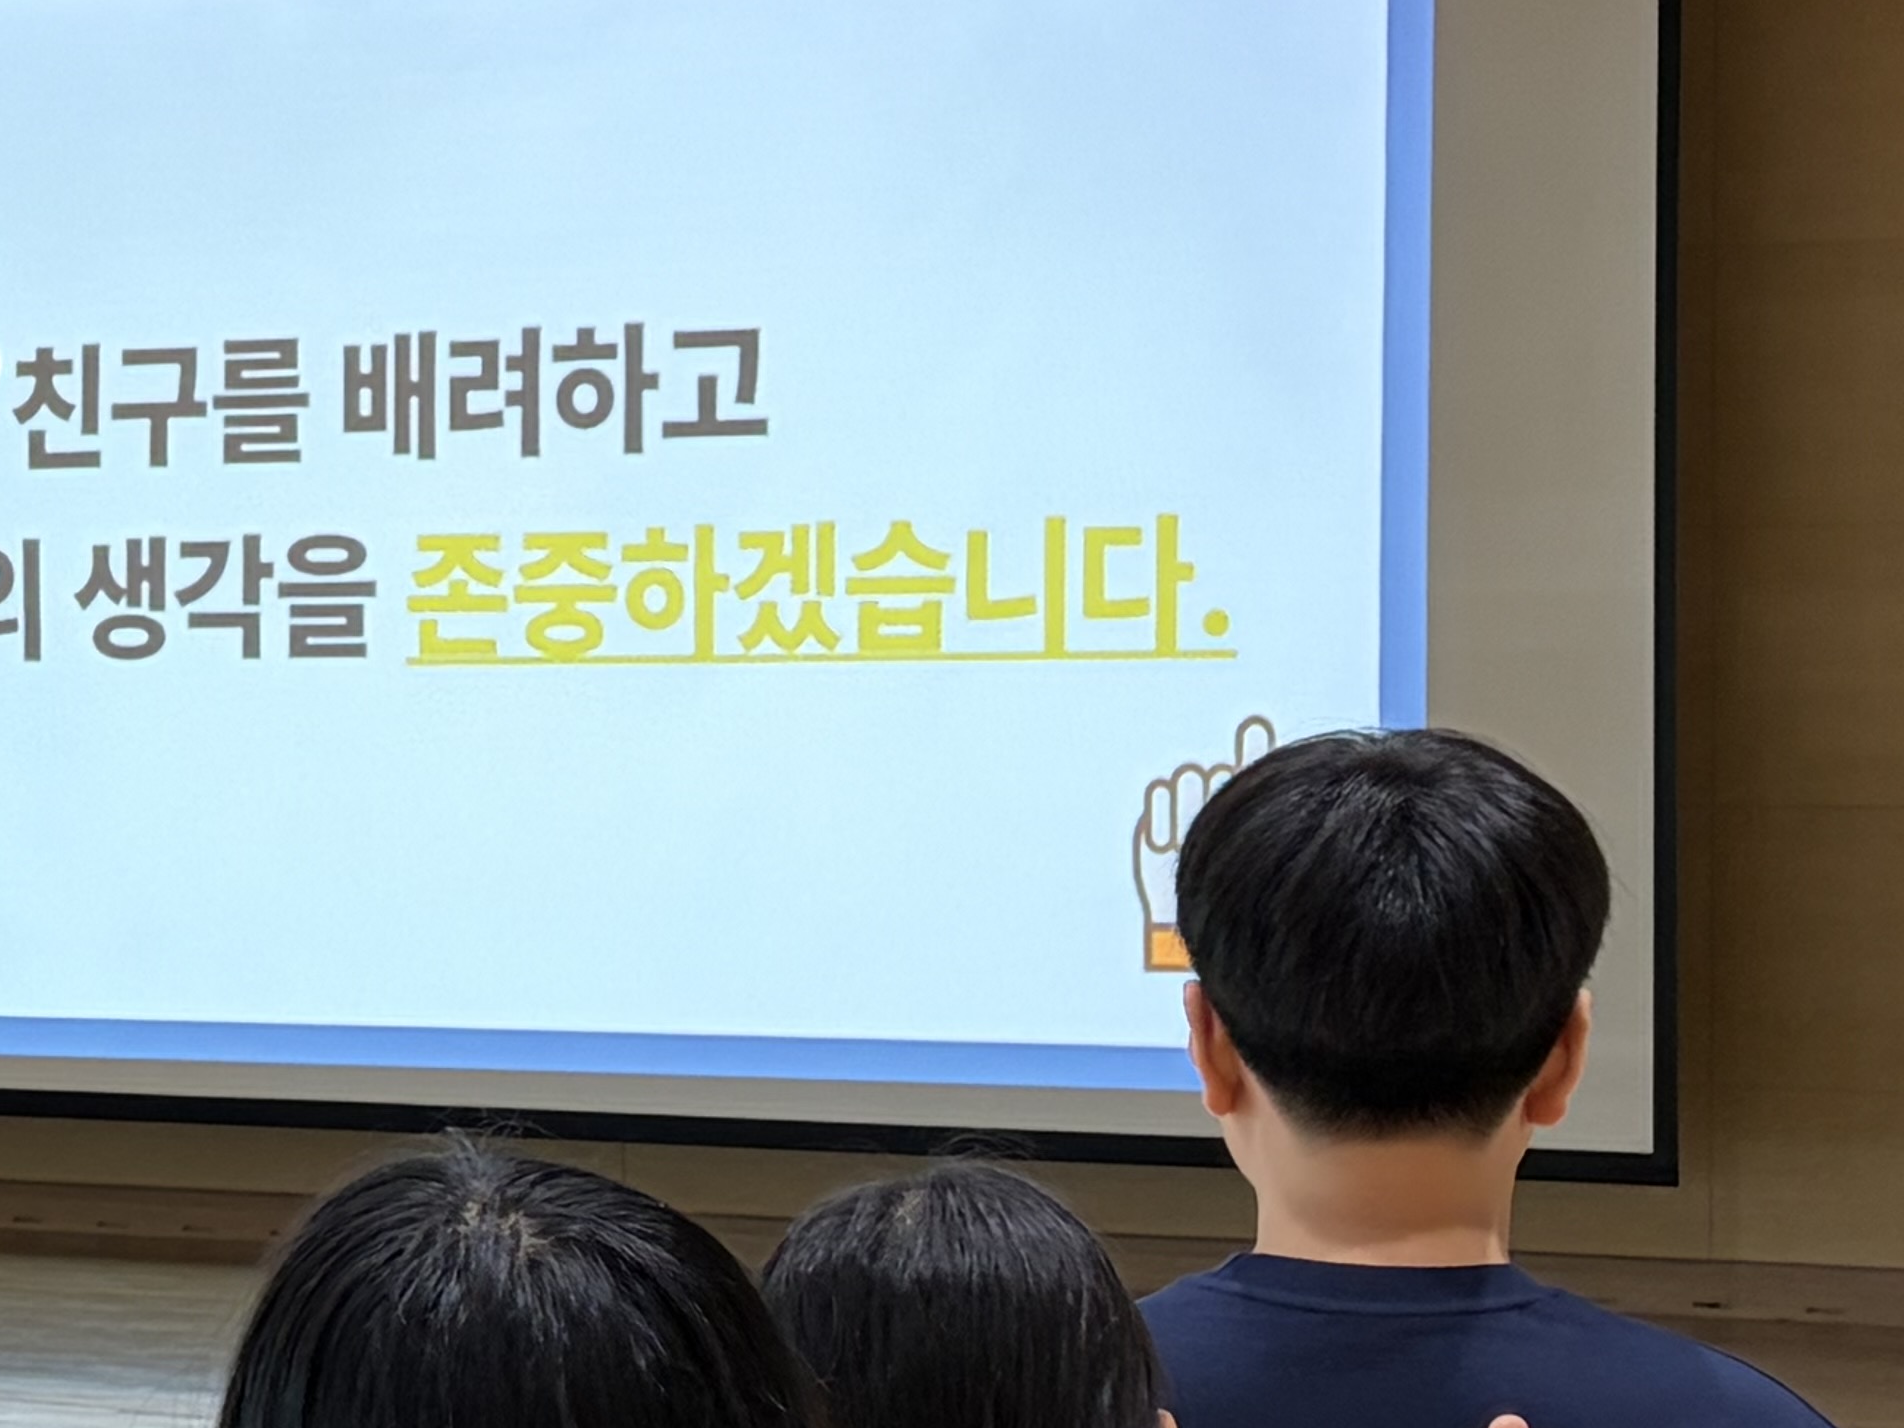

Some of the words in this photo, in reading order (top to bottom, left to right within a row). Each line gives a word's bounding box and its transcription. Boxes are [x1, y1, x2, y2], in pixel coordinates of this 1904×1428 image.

[12, 337, 310, 471] 친구를
[342, 322, 770, 461] 배려하고
[73, 534, 377, 662] 생각을
[406, 512, 1233, 659] 존중하겠습니다.
